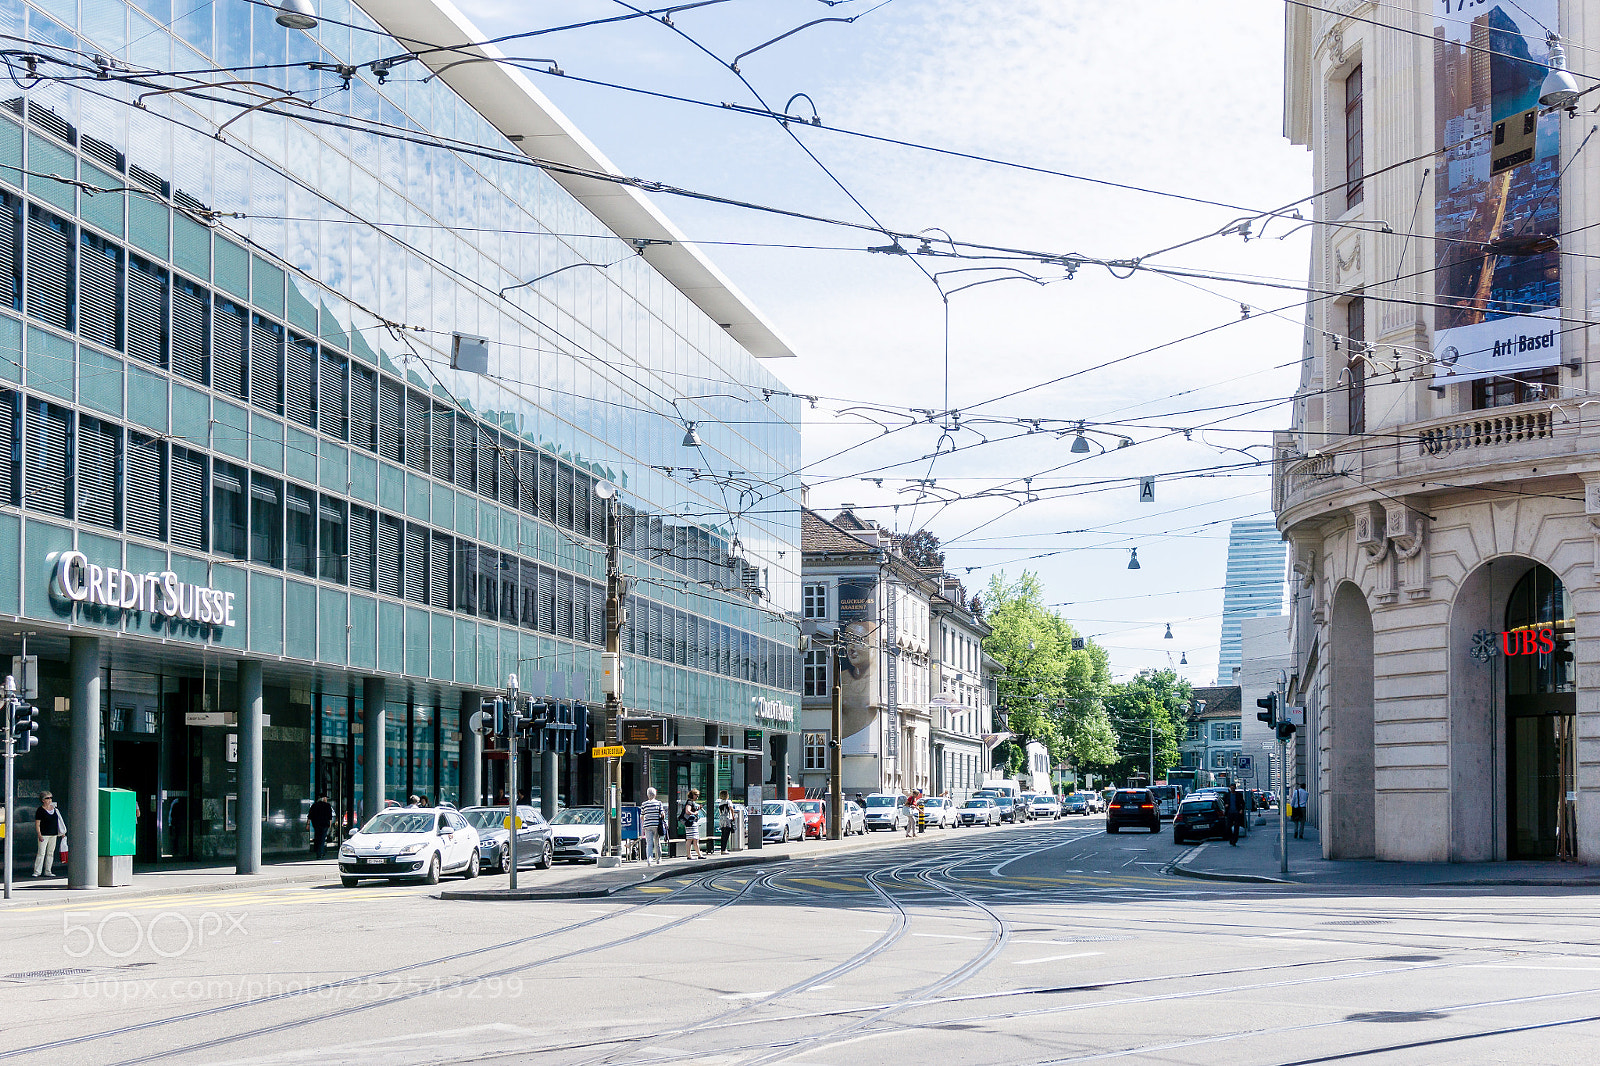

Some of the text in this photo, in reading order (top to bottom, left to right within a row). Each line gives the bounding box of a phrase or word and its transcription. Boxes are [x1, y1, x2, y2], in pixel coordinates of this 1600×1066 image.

[1492, 330, 1554, 357] Art Basel
[1142, 481, 1153, 498] A
[57, 551, 236, 627] CREDIT SUISSE
[1072, 639, 1083, 648] 30
[1501, 628, 1554, 656] UBS
[888, 667, 896, 682] und
